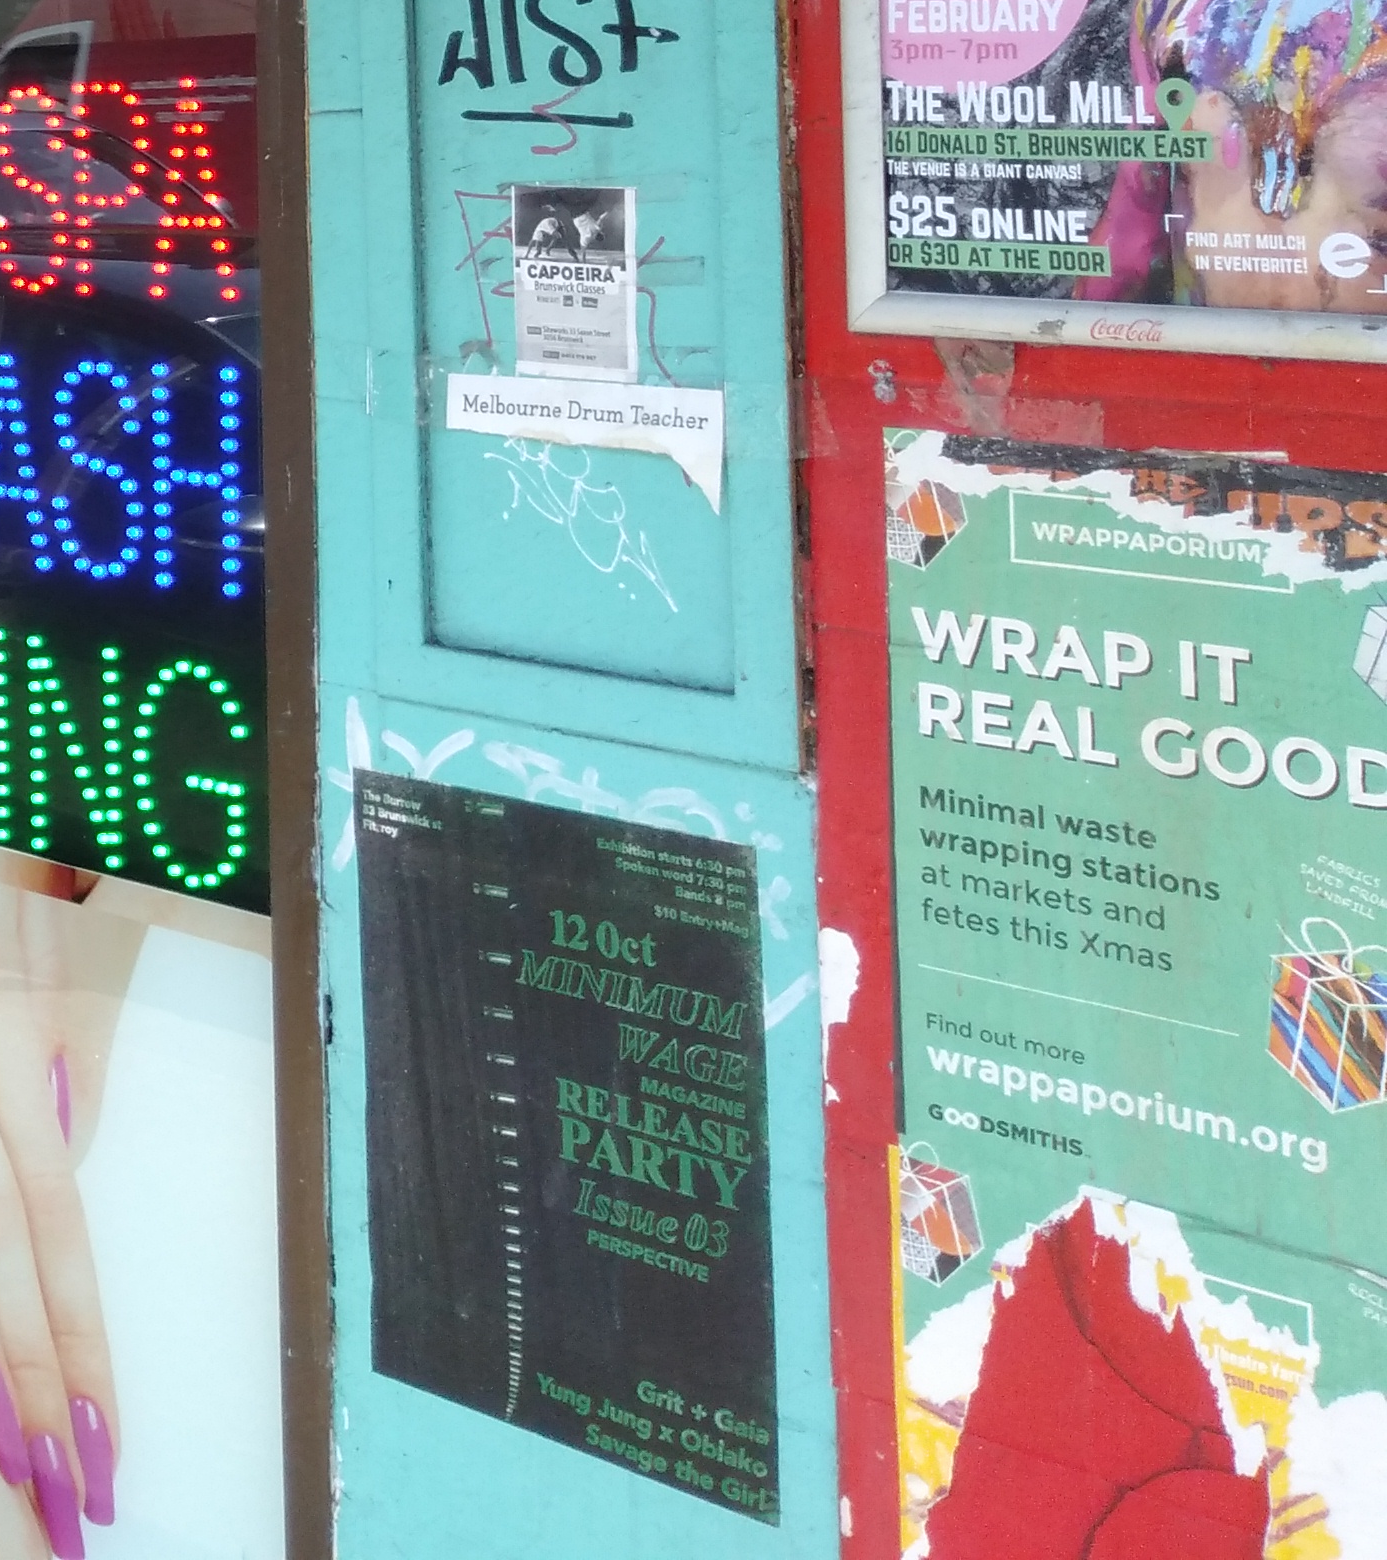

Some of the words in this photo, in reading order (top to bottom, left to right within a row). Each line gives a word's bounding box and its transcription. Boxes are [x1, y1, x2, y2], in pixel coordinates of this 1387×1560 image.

[891, 39, 1018, 64] 3pm-7pm
[957, 81, 1056, 124] WOOL
[1070, 81, 1156, 125] MILL
[887, 130, 915, 153] 161
[918, 131, 988, 156] DONALD
[1028, 133, 1145, 158] BRUNSWICK
[1155, 133, 1208, 159] EAST
[912, 162, 951, 177] VENUE
[954, 163, 966, 177] IS
[970, 163, 981, 178] A
[984, 163, 1022, 179] GIANT
[1026, 163, 1082, 180] CANVAS!
[889, 195, 957, 240] $25
[971, 208, 1089, 244] ONLINE
[1186, 232, 1217, 249] FIND
[1223, 233, 1250, 249] ART
[1256, 233, 1307, 251] MULCH
[526, 264, 615, 283] CAPOEIRA
[889, 243, 914, 266] OR
[920, 242, 960, 269] $30
[968, 248, 993, 269] AT
[1001, 249, 1042, 271] THE
[1049, 250, 1106, 273] DOOR
[1195, 254, 1209, 271] IN
[1214, 254, 1309, 274] EVENTBRITE!
[534, 280, 575, 293] Brunswick
[576, 282, 606, 295] Classes
[462, 394, 561, 418] Melbourne
[567, 400, 624, 424] Drum
[631, 405, 708, 430] Teacher
[1032, 521, 1262, 564] WRAPPAPORIUM
[911, 606, 1152, 688] WRAP
[1179, 640, 1253, 706] IT
[917, 681, 1120, 768] REAL
[1140, 716, 1387, 810] GOOD
[362, 789, 381, 803] The
[378, 806, 430, 829] Brunswick
[920, 785, 1046, 830] Minimal
[1055, 813, 1157, 849] waste
[596, 838, 655, 860] Exhibition
[658, 850, 693, 868] starts
[695, 858, 723, 874] 6:30
[726, 866, 746, 879] pm
[615, 857, 659, 877] Spoken
[662, 869, 694, 884] word
[696, 873, 724, 890] 7:30
[726, 881, 747, 895] pm
[920, 827, 1073, 879] wrapping
[1082, 855, 1221, 902] stations
[654, 905, 677, 921] $10
[675, 885, 712, 904] Bands
[726, 899, 747, 911] pm
[921, 864, 951, 888] at
[962, 872, 1093, 916] markets
[1103, 899, 1167, 931] and
[549, 910, 589, 951] 12
[596, 920, 657, 967] Oct
[922, 898, 1000, 936] fetes
[1010, 916, 1069, 951] this
[1081, 930, 1173, 972] Xmas
[516, 949, 748, 1040] MINIMUM
[619, 1023, 749, 1091] WAGE
[926, 1012, 972, 1039] Find
[980, 1028, 1017, 1050] out
[1024, 1038, 1087, 1066] more
[555, 1077, 753, 1165] RELEASE
[640, 1076, 746, 1120] MAGAZINE
[927, 1044, 1329, 1173] wrappaporium.org
[928, 1104, 1083, 1157] GOODSMITHS
[557, 1114, 748, 1211] PARTY
[573, 1178, 679, 1244] Issue
[684, 1213, 729, 1259] 03
[587, 1229, 710, 1284] PERSPECTIVE
[537, 1372, 591, 1416] Yung
[598, 1398, 652, 1440] Jung
[658, 1424, 675, 1444] x
[636, 1380, 685, 1416] Grit
[691, 1403, 707, 1422] +
[714, 1408, 770, 1446] Gaia
[585, 1423, 669, 1473] Savage
[674, 1460, 714, 1490] the
